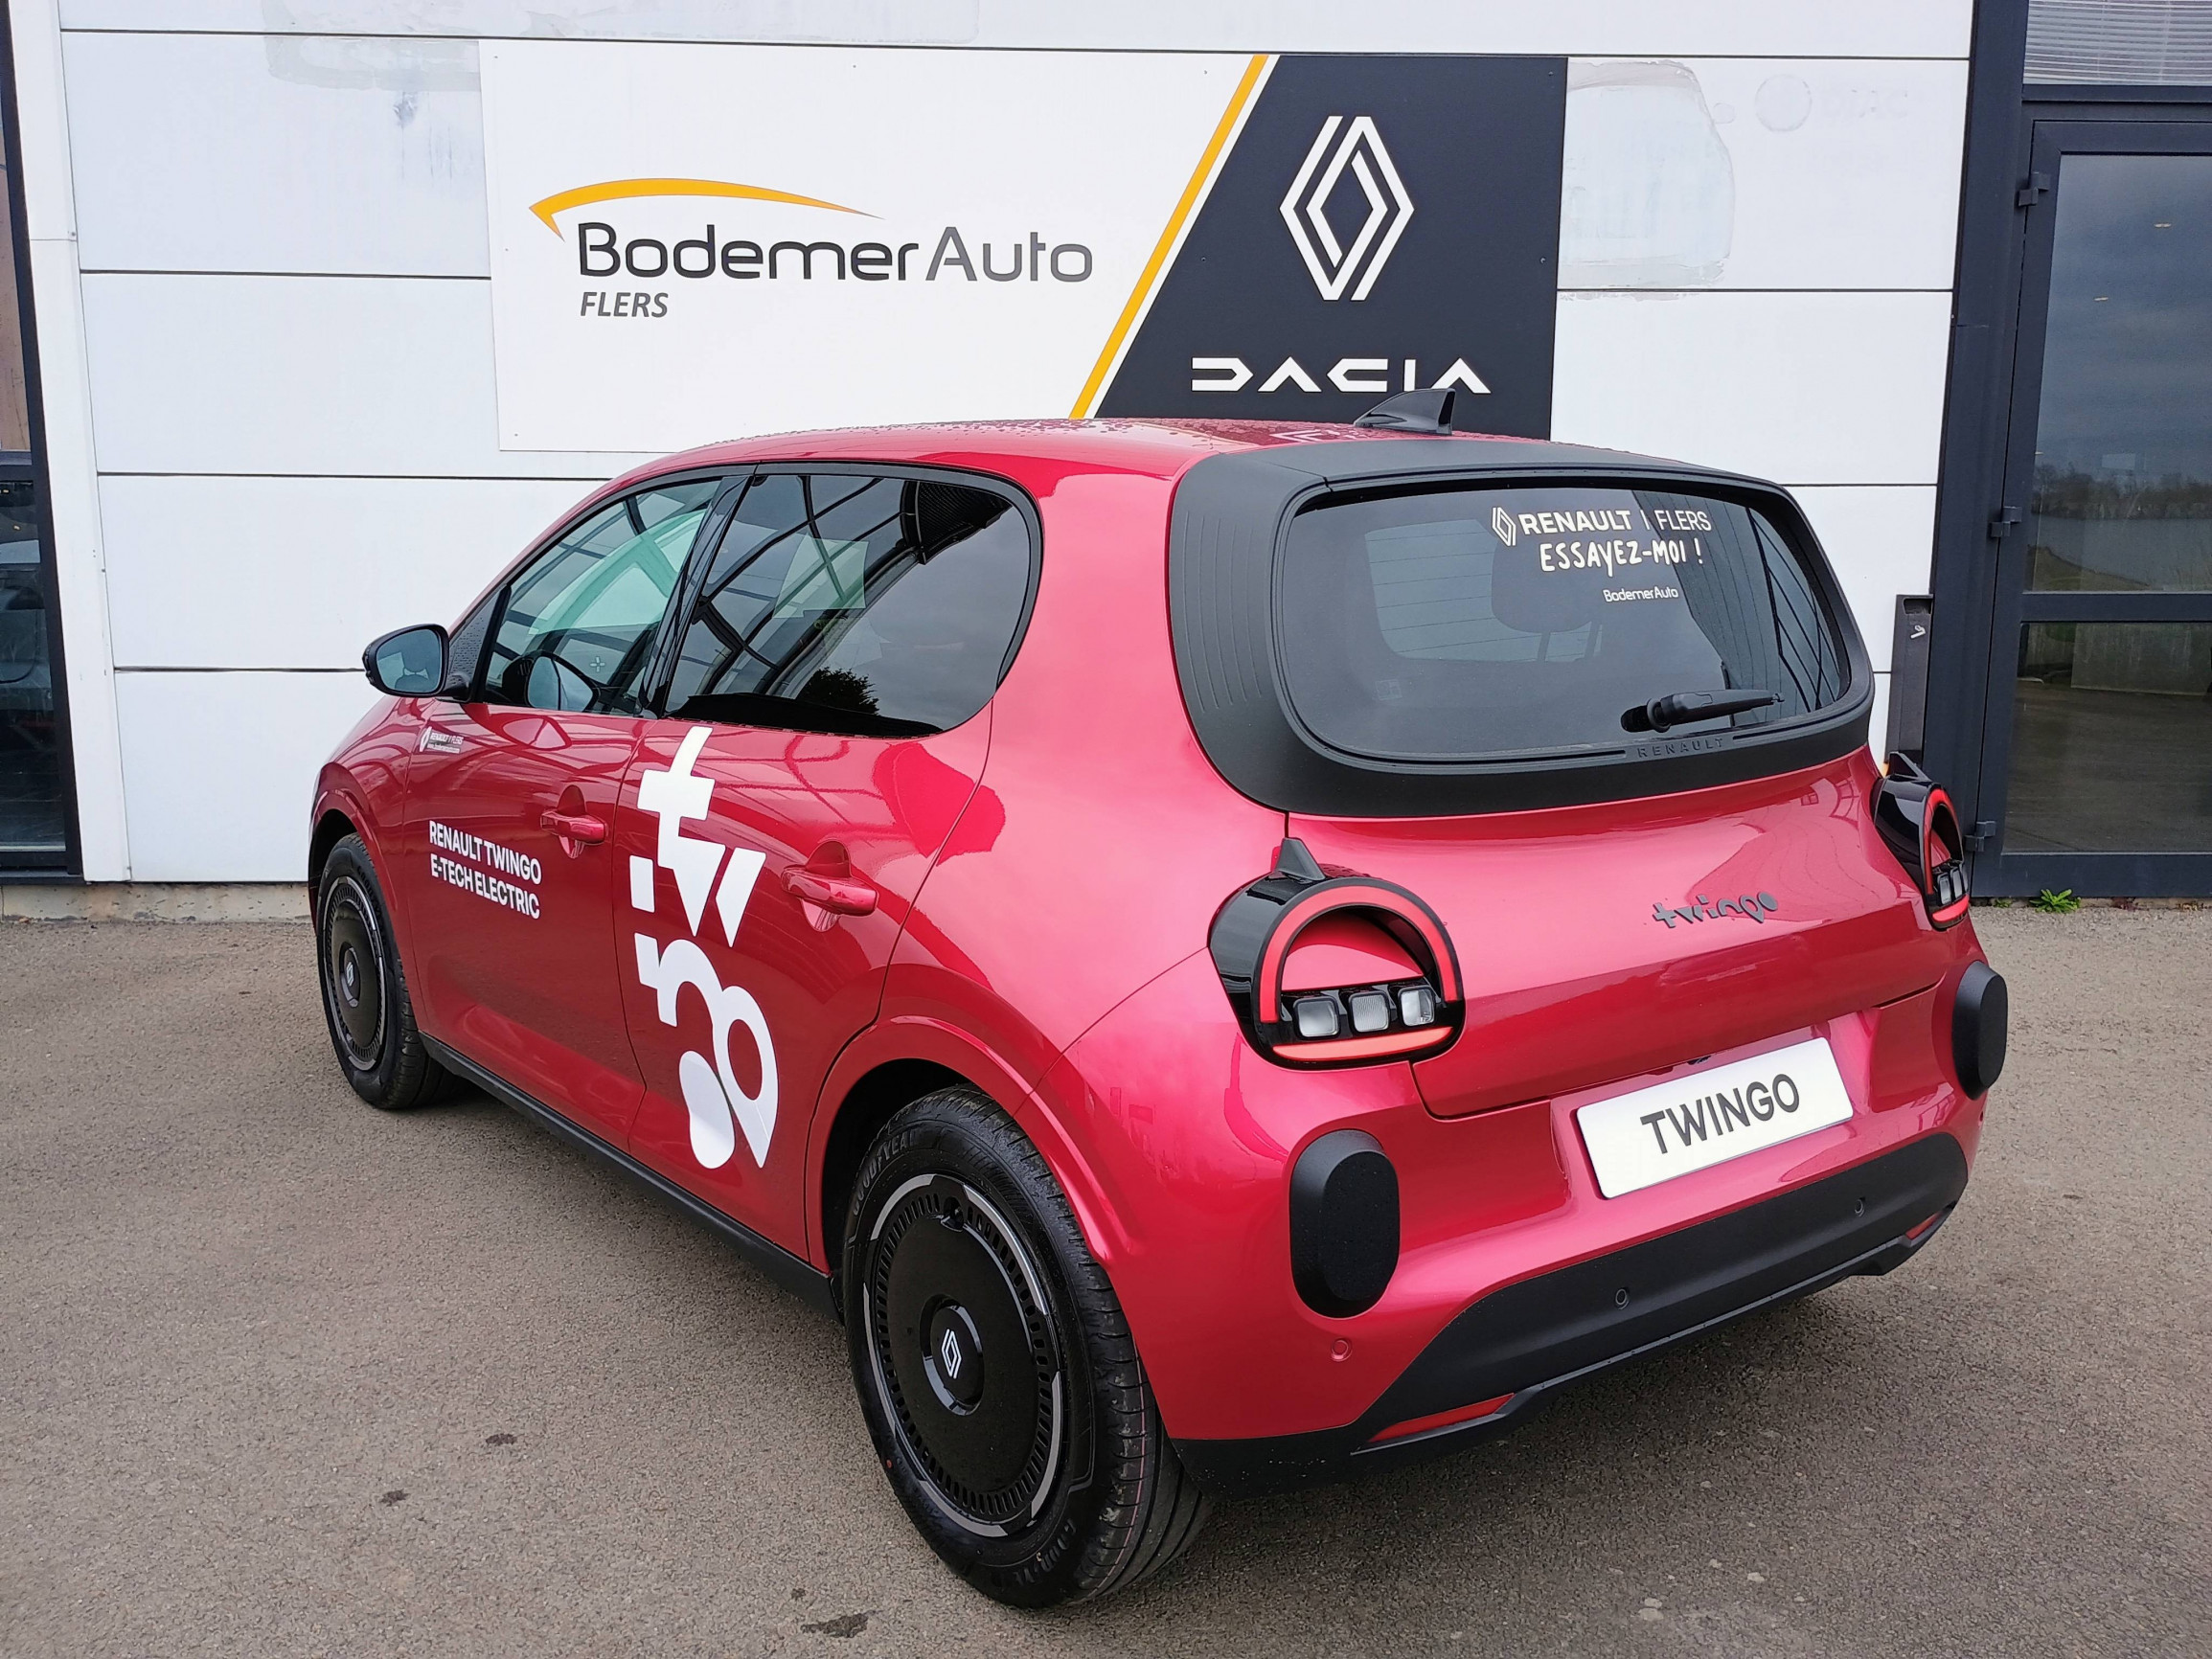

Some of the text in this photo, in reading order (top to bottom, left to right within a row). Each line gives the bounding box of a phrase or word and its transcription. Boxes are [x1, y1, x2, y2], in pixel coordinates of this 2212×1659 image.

[579, 222, 1092, 282] BodemerAuto
[581, 291, 669, 318] FLERS
[1191, 356, 1492, 394] DACIA
[1518, 510, 1711, 534] RENAULT FLERS
[1539, 540, 1686, 577] ESSAYEZ-MOI
[1603, 585, 1679, 602] BodemerAuto
[1636, 737, 1724, 759] RENAULT
[429, 820, 542, 885] RENAULT TWINGO
[430, 852, 540, 920] E-TECH ELECTRIC
[1653, 893, 1778, 928] twingo
[1641, 1074, 1800, 1153] TWINGO
